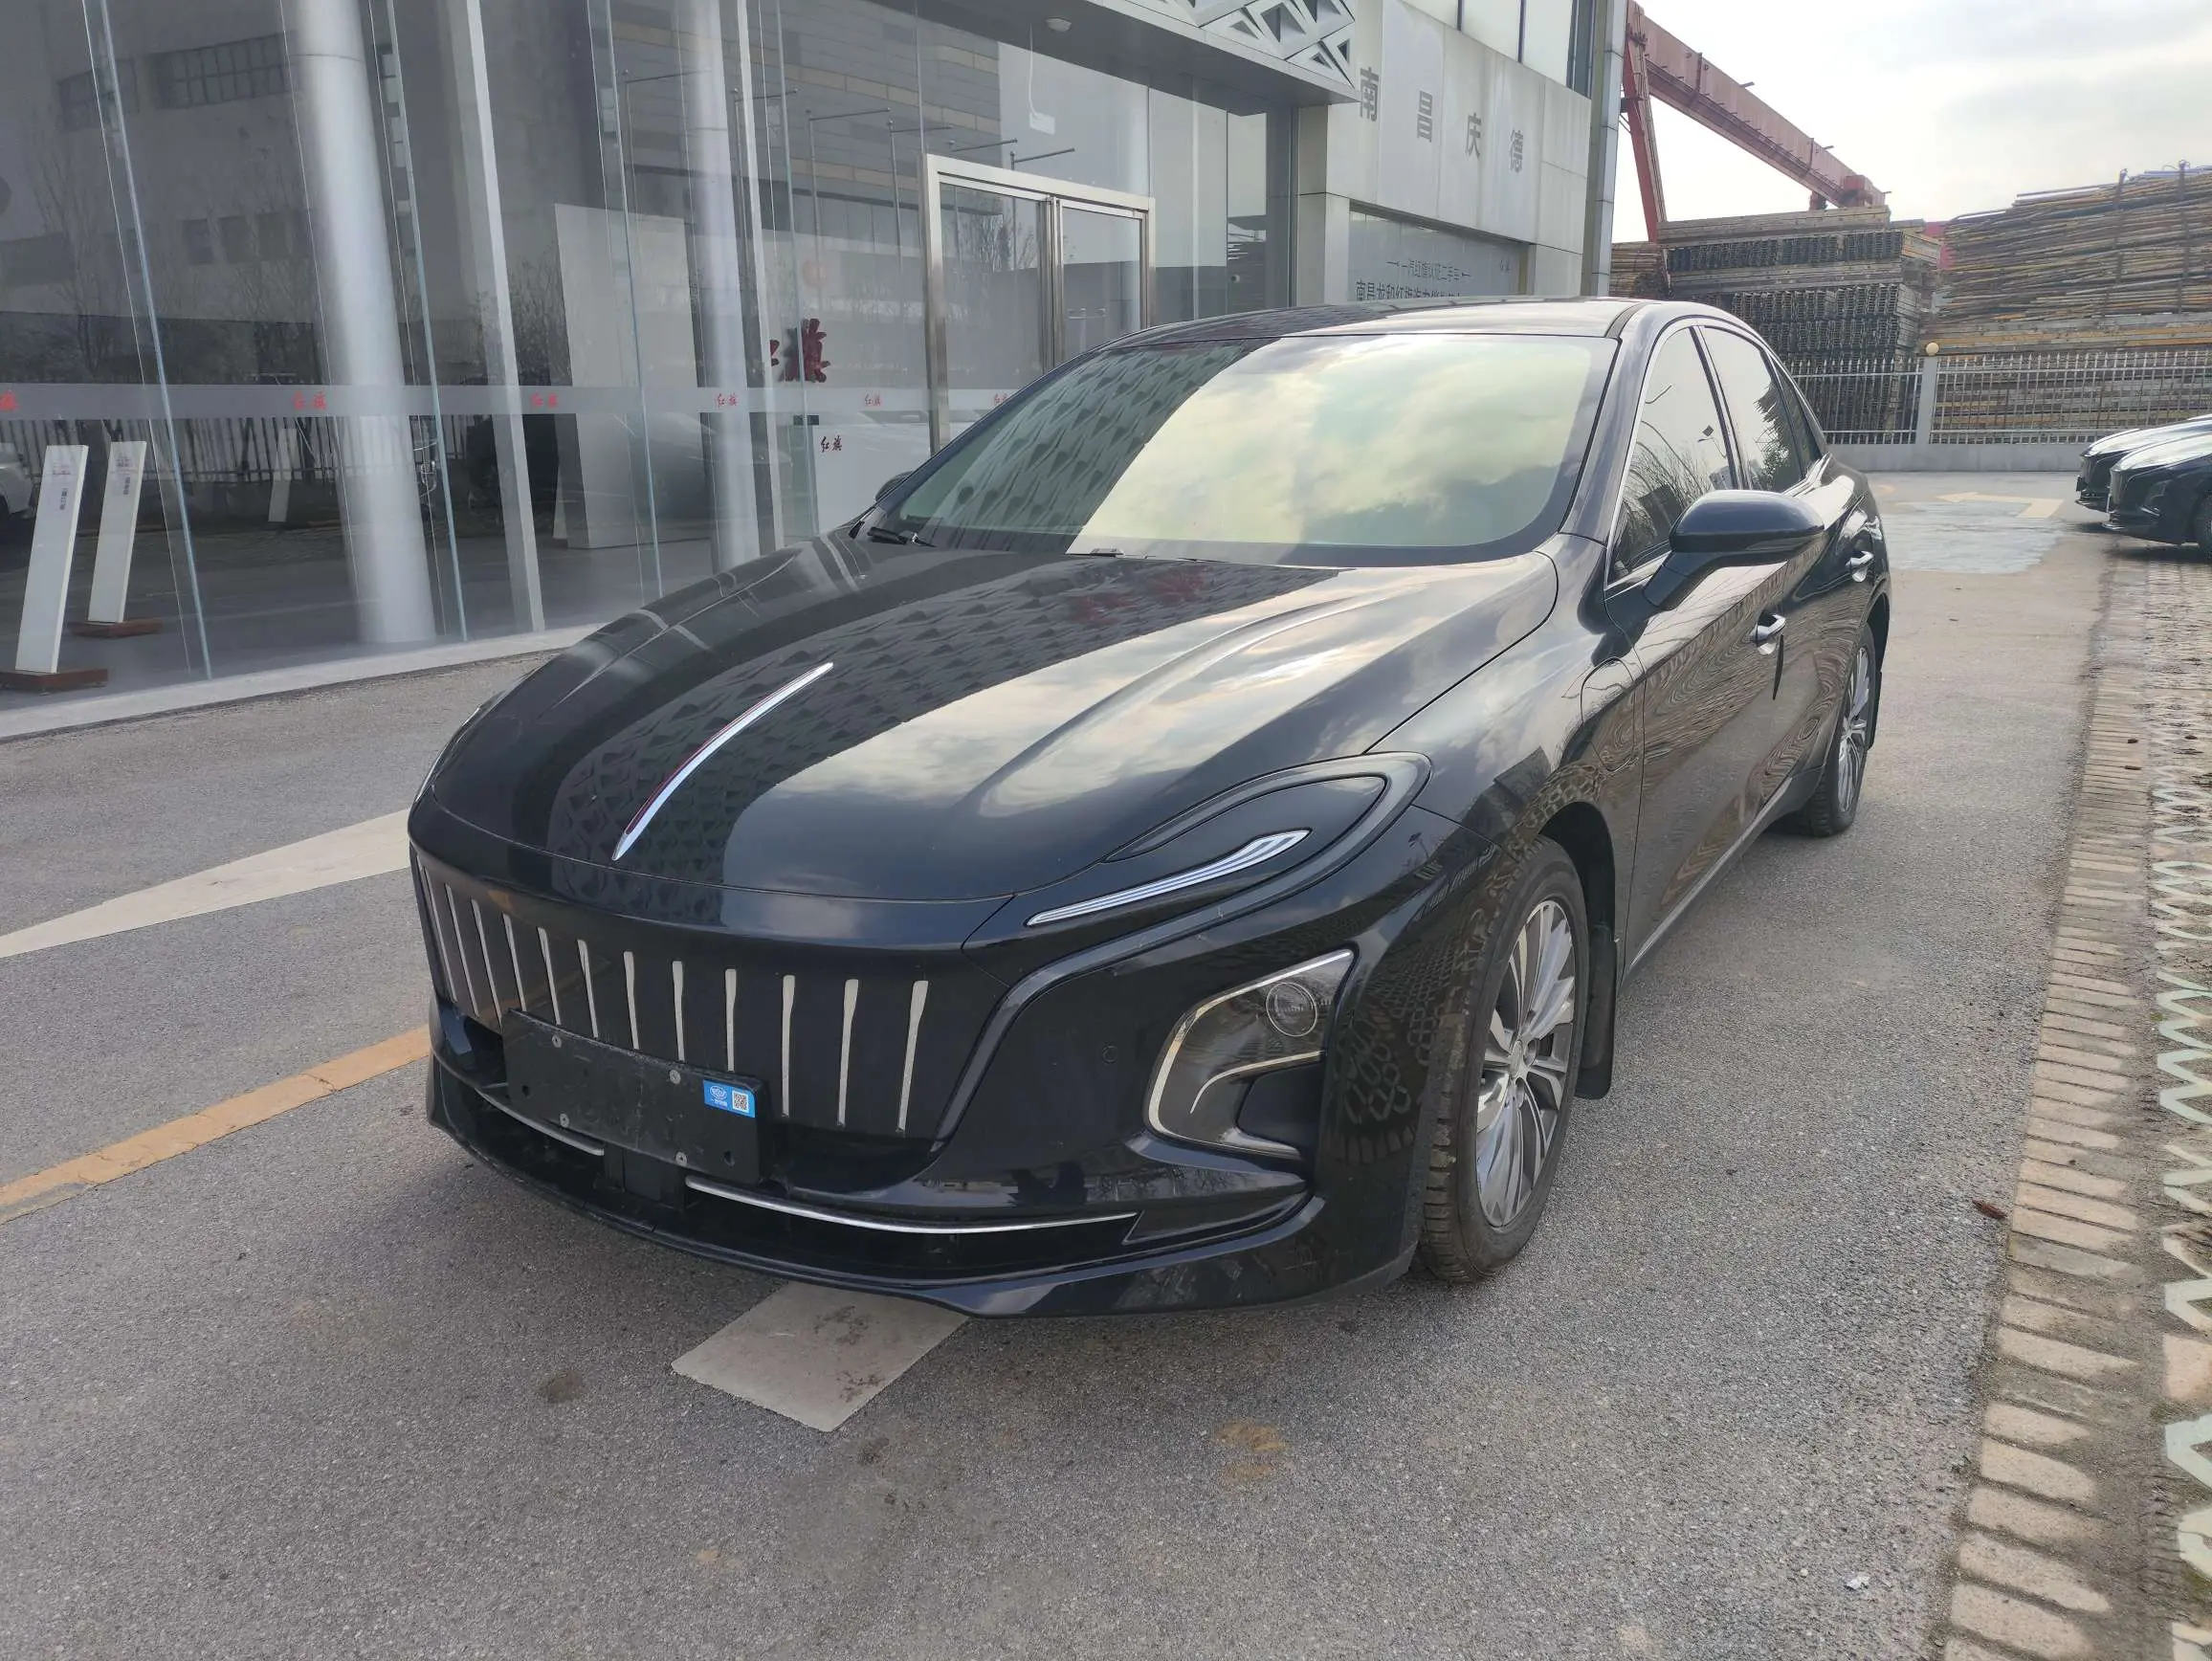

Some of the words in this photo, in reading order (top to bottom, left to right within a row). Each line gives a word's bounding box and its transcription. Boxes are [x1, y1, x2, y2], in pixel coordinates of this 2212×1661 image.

[1360, 66, 1524, 173] 南昌庆德
[820, 435, 843, 453] 红旗
